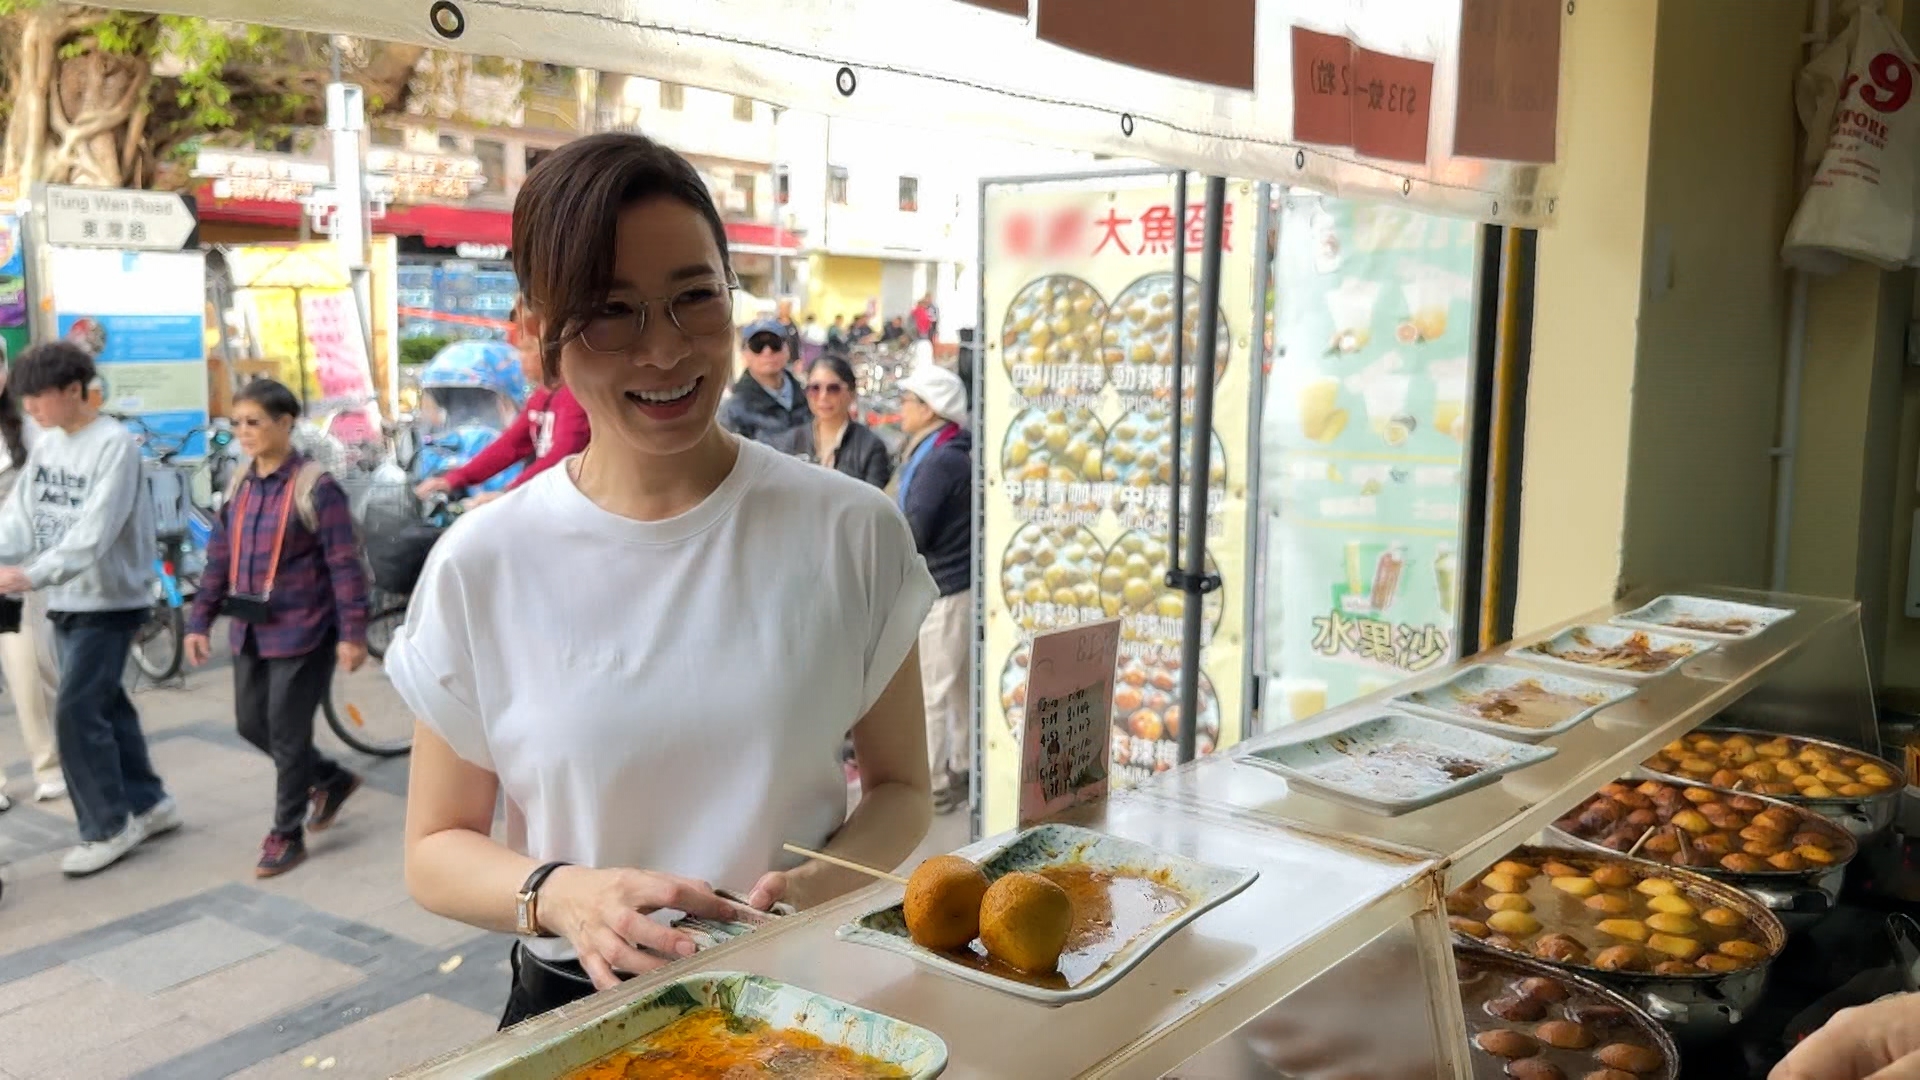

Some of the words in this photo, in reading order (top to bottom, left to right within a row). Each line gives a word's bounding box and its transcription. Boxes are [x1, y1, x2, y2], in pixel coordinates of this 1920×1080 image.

[54, 193, 90, 214] Tung
[96, 195, 129, 213] Wan
[132, 197, 173, 216] Road
[1312, 610, 1448, 672] 水果沙
